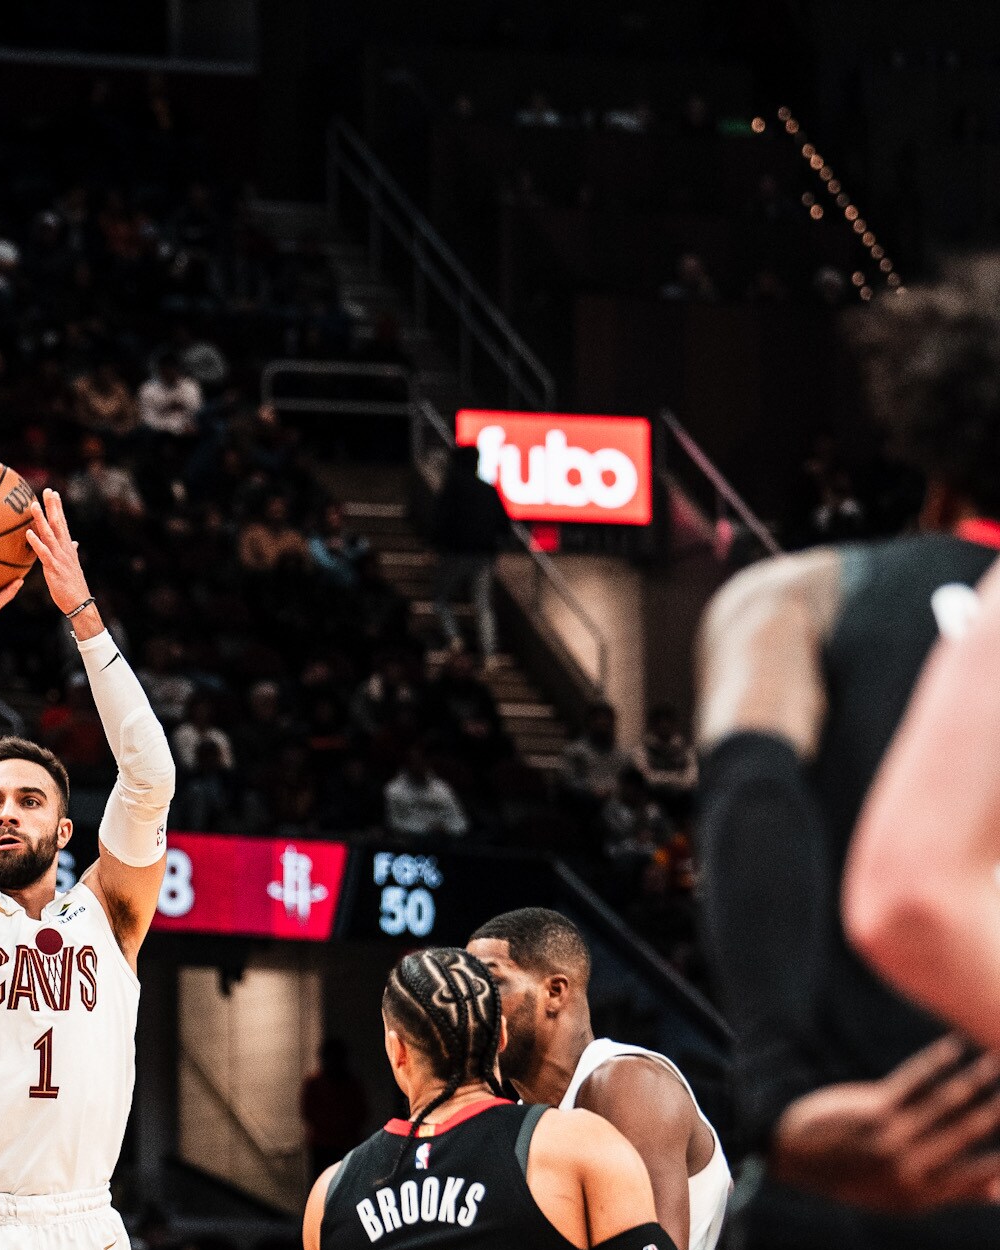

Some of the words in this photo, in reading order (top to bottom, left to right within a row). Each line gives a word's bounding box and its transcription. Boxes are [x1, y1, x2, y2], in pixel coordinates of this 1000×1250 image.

[476, 425, 638, 509] fubo
[379, 886, 436, 938] 50
[29, 1026, 60, 1099] 1
[356, 1176, 486, 1243] BROOKS
